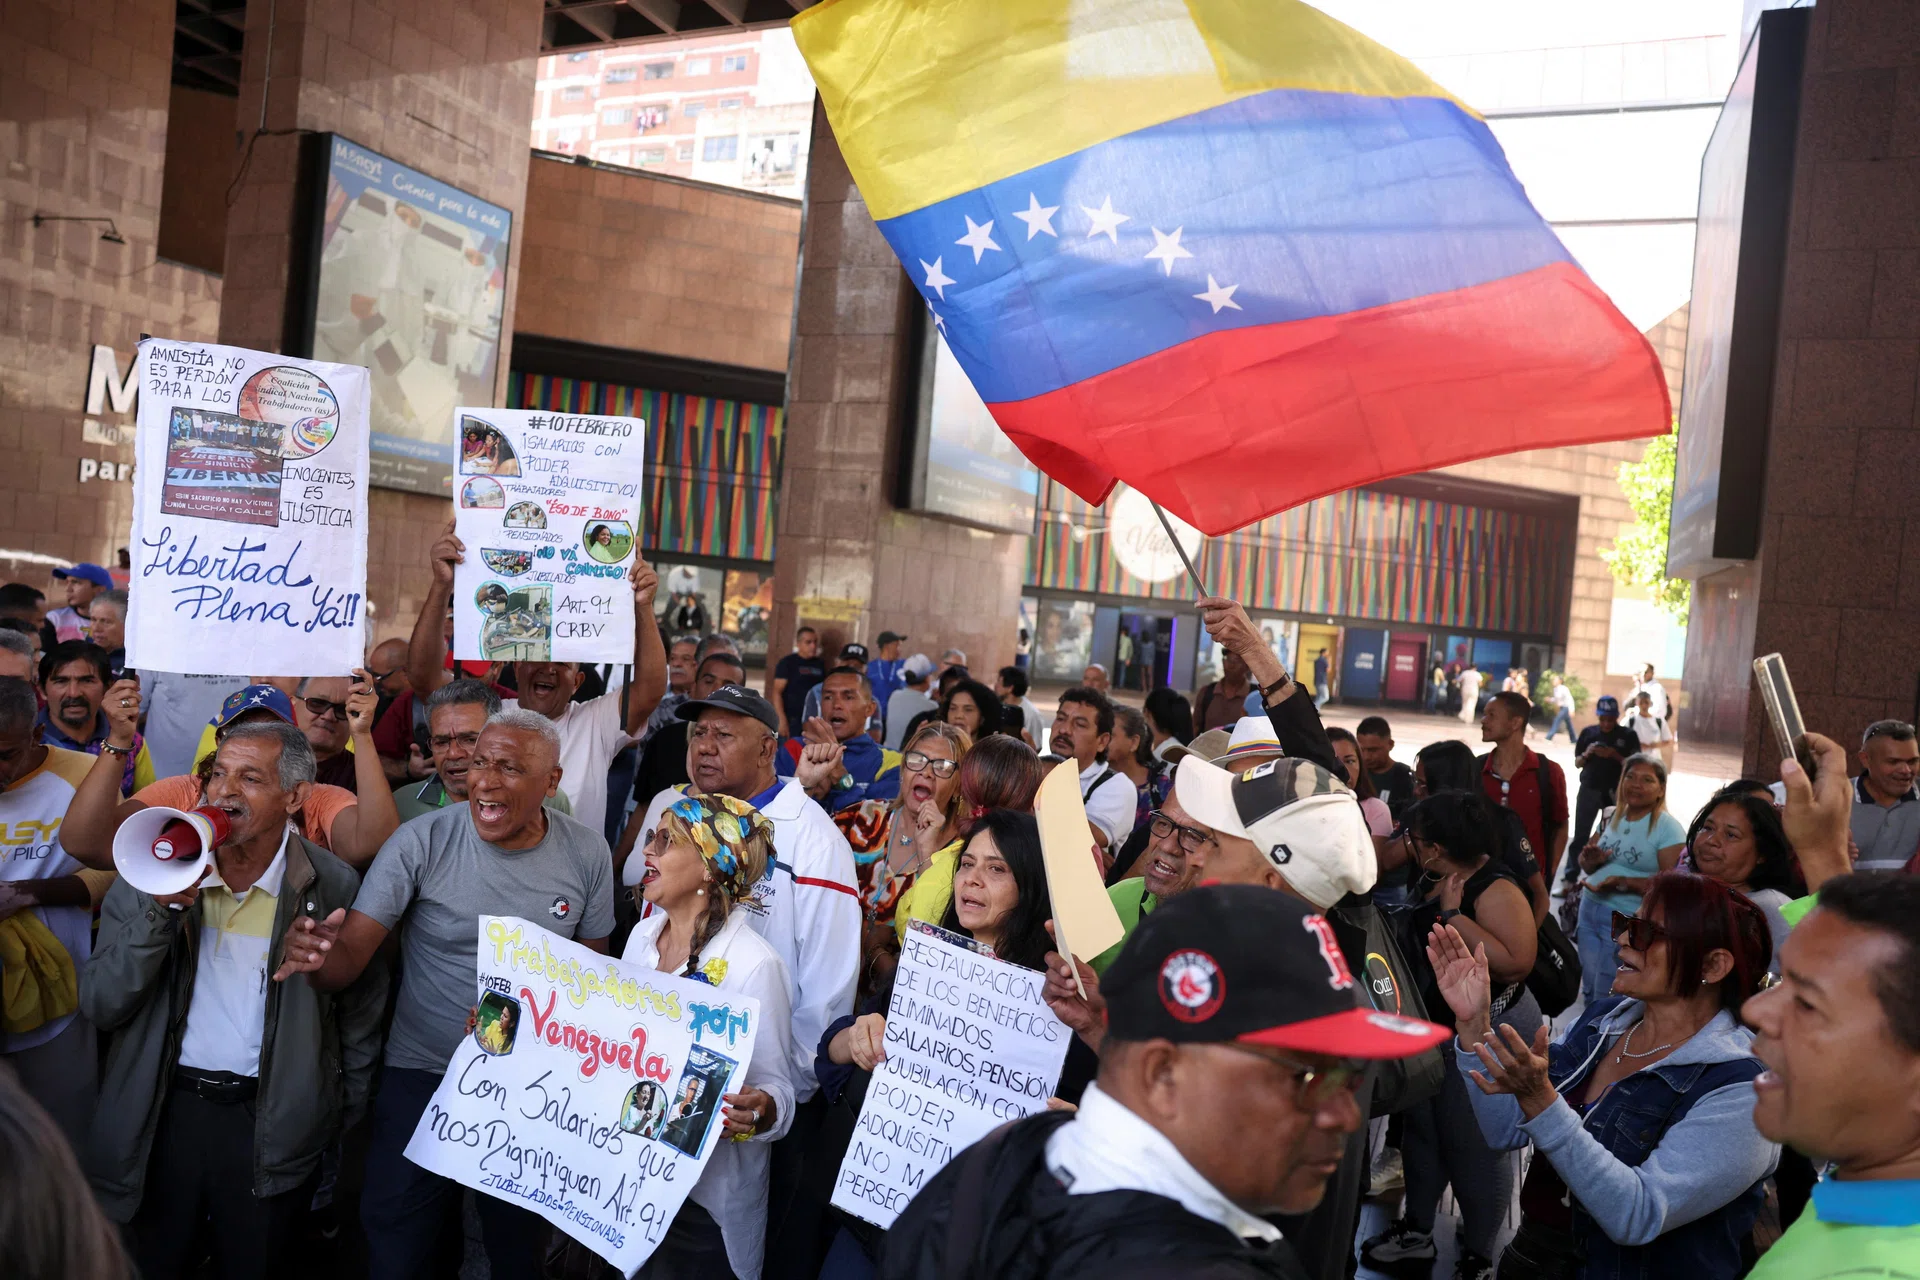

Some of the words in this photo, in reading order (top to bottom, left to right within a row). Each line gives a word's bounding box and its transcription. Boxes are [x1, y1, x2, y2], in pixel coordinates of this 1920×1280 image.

[149, 346, 214, 368] AMNISTÍA
[223, 357, 246, 370] NO
[149, 362, 168, 378] ES
[174, 366, 240, 386] PERDÓN
[271, 377, 311, 391] Coalición
[149, 380, 193, 400] PARA
[201, 386, 232, 404] LOS
[288, 391, 327, 404] Nacional
[258, 396, 313, 413] Trabajadores
[180, 452, 255, 464] LIBERTAD
[594, 443, 622, 456] CON
[204, 460, 253, 469] SINDICAL
[521, 454, 570, 475] PODER
[167, 467, 281, 484] LIBERTAD
[303, 485, 324, 500] ES
[502, 484, 566, 497] TRABAJADORES
[280, 501, 353, 529] JUSTICIA
[503, 529, 564, 543] PENSIONADOS
[142, 526, 313, 587] Libertad
[525, 570, 577, 585] JUBILADOS
[171, 584, 299, 629] Plena
[590, 595, 614, 615] 91
[555, 621, 606, 639] CRBV
[478, 971, 512, 993] #10FEB
[895, 966, 918, 991] DE
[925, 976, 960, 1006] LOS
[518, 986, 674, 1083] Venezuela
[457, 1053, 507, 1111] Con
[872, 1081, 955, 1133] PODER
[853, 1141, 891, 1174] NO
[479, 1119, 601, 1202] Dignifiquen
[640, 1202, 666, 1244] 91
